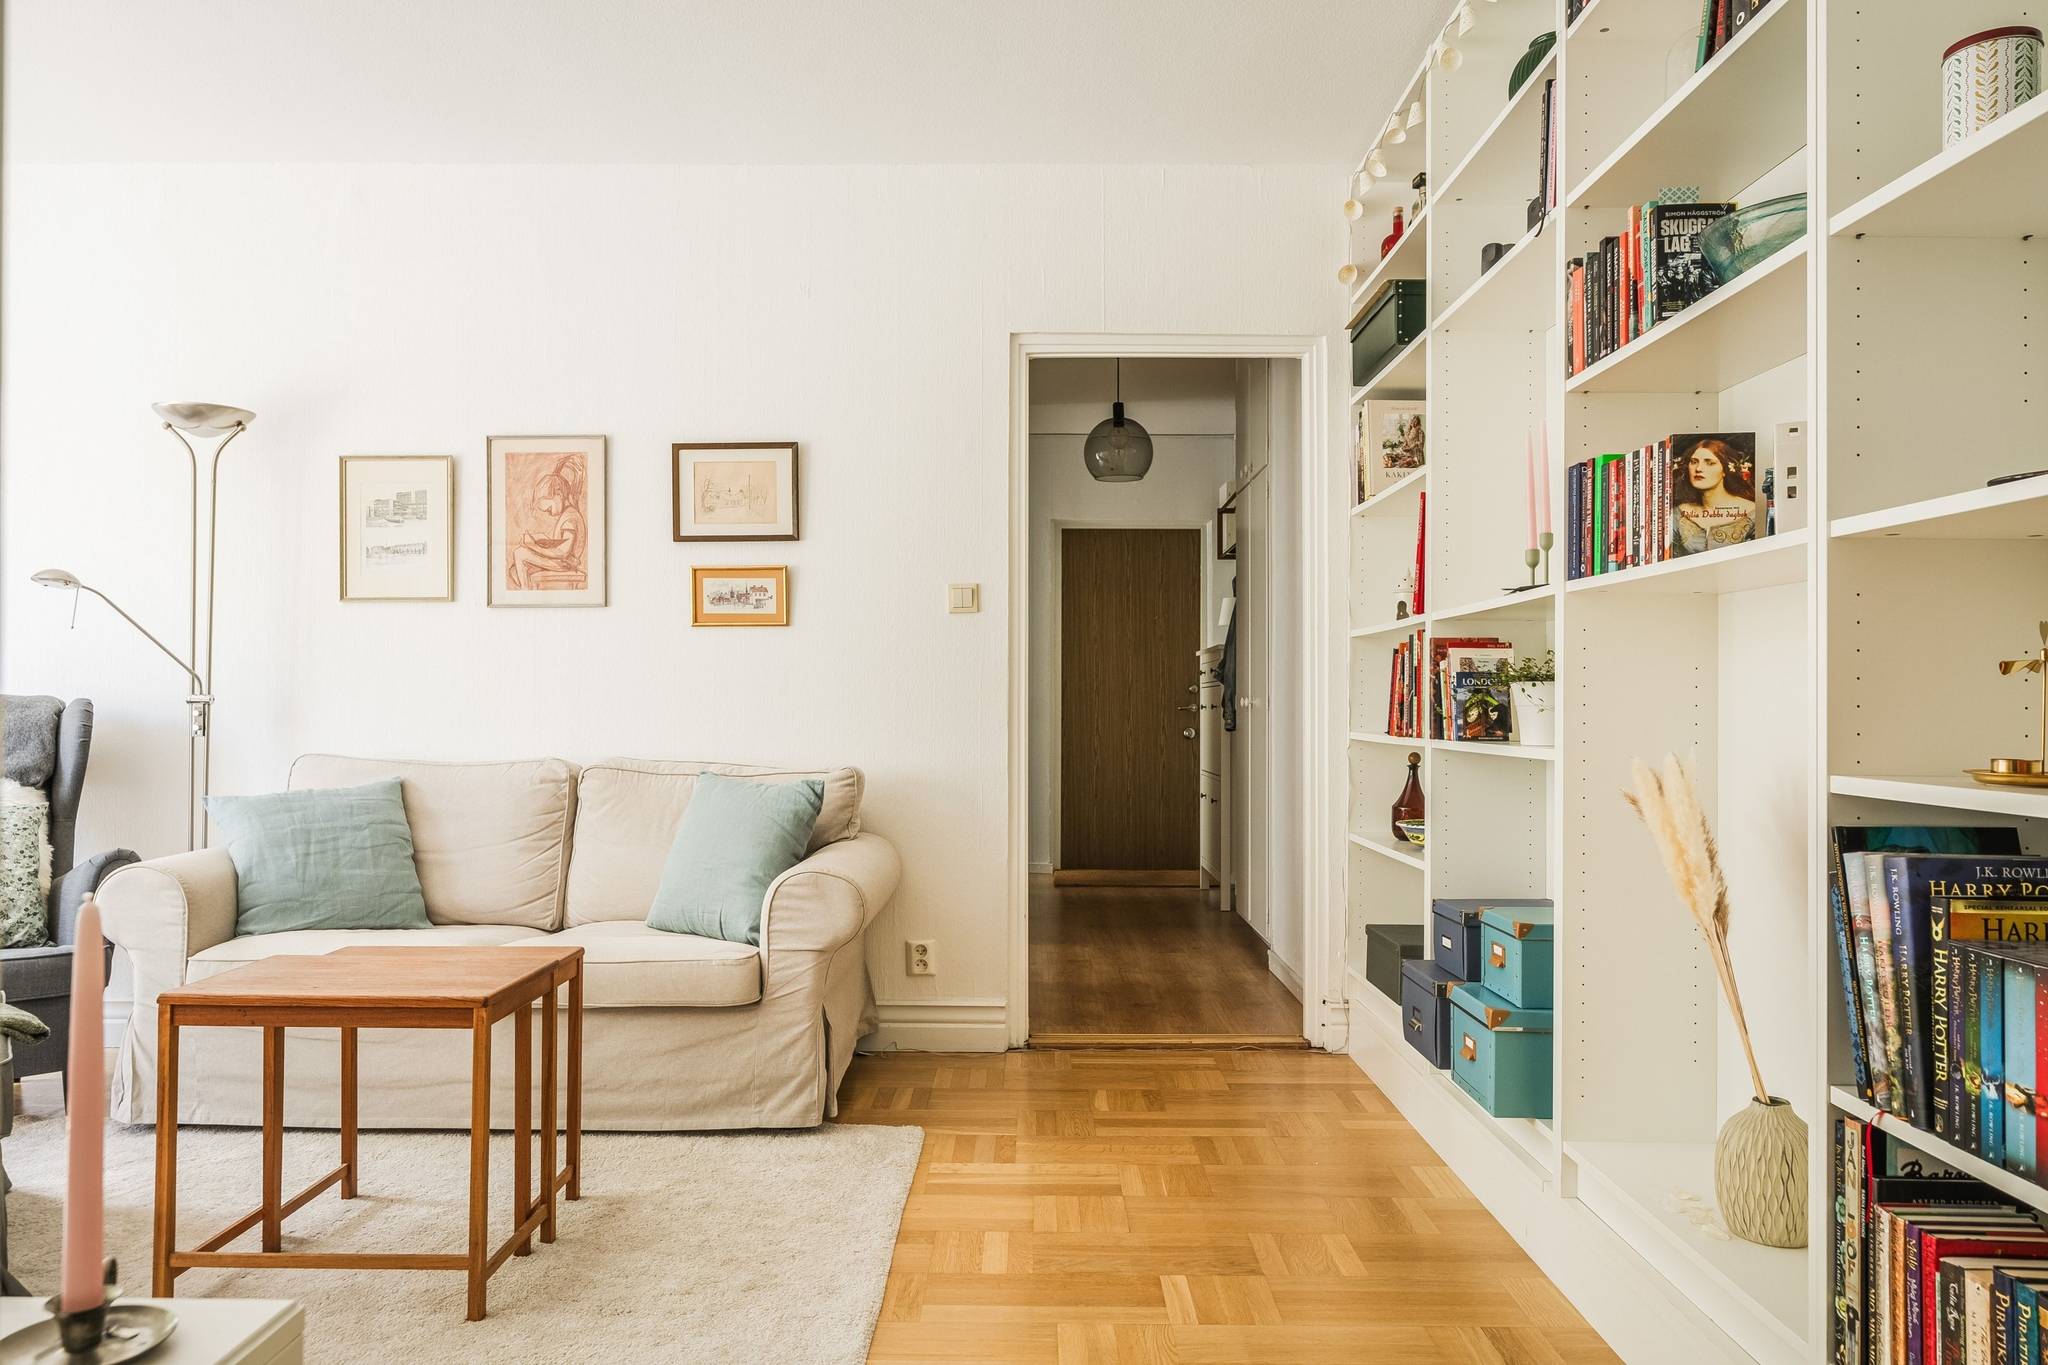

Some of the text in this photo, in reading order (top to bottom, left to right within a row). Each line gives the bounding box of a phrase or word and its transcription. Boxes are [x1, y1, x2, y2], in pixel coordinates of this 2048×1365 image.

[1664, 236, 1691, 253] LAG
[1976, 866, 1998, 879] J.K.
[1890, 868, 1902, 936] J.K. ROWLING
[1929, 880, 2012, 897] HARRY
[1982, 917, 2048, 941] HAR
[1951, 956, 1961, 985] HARRY
[1898, 944, 1912, 1036] HARRY POTTER
[1933, 949, 1948, 1082] HARRY POTTER
[1847, 1131, 1857, 1190] JAN
[1906, 1238, 1917, 1271] Molly
[1949, 1282, 1959, 1305] Celia
